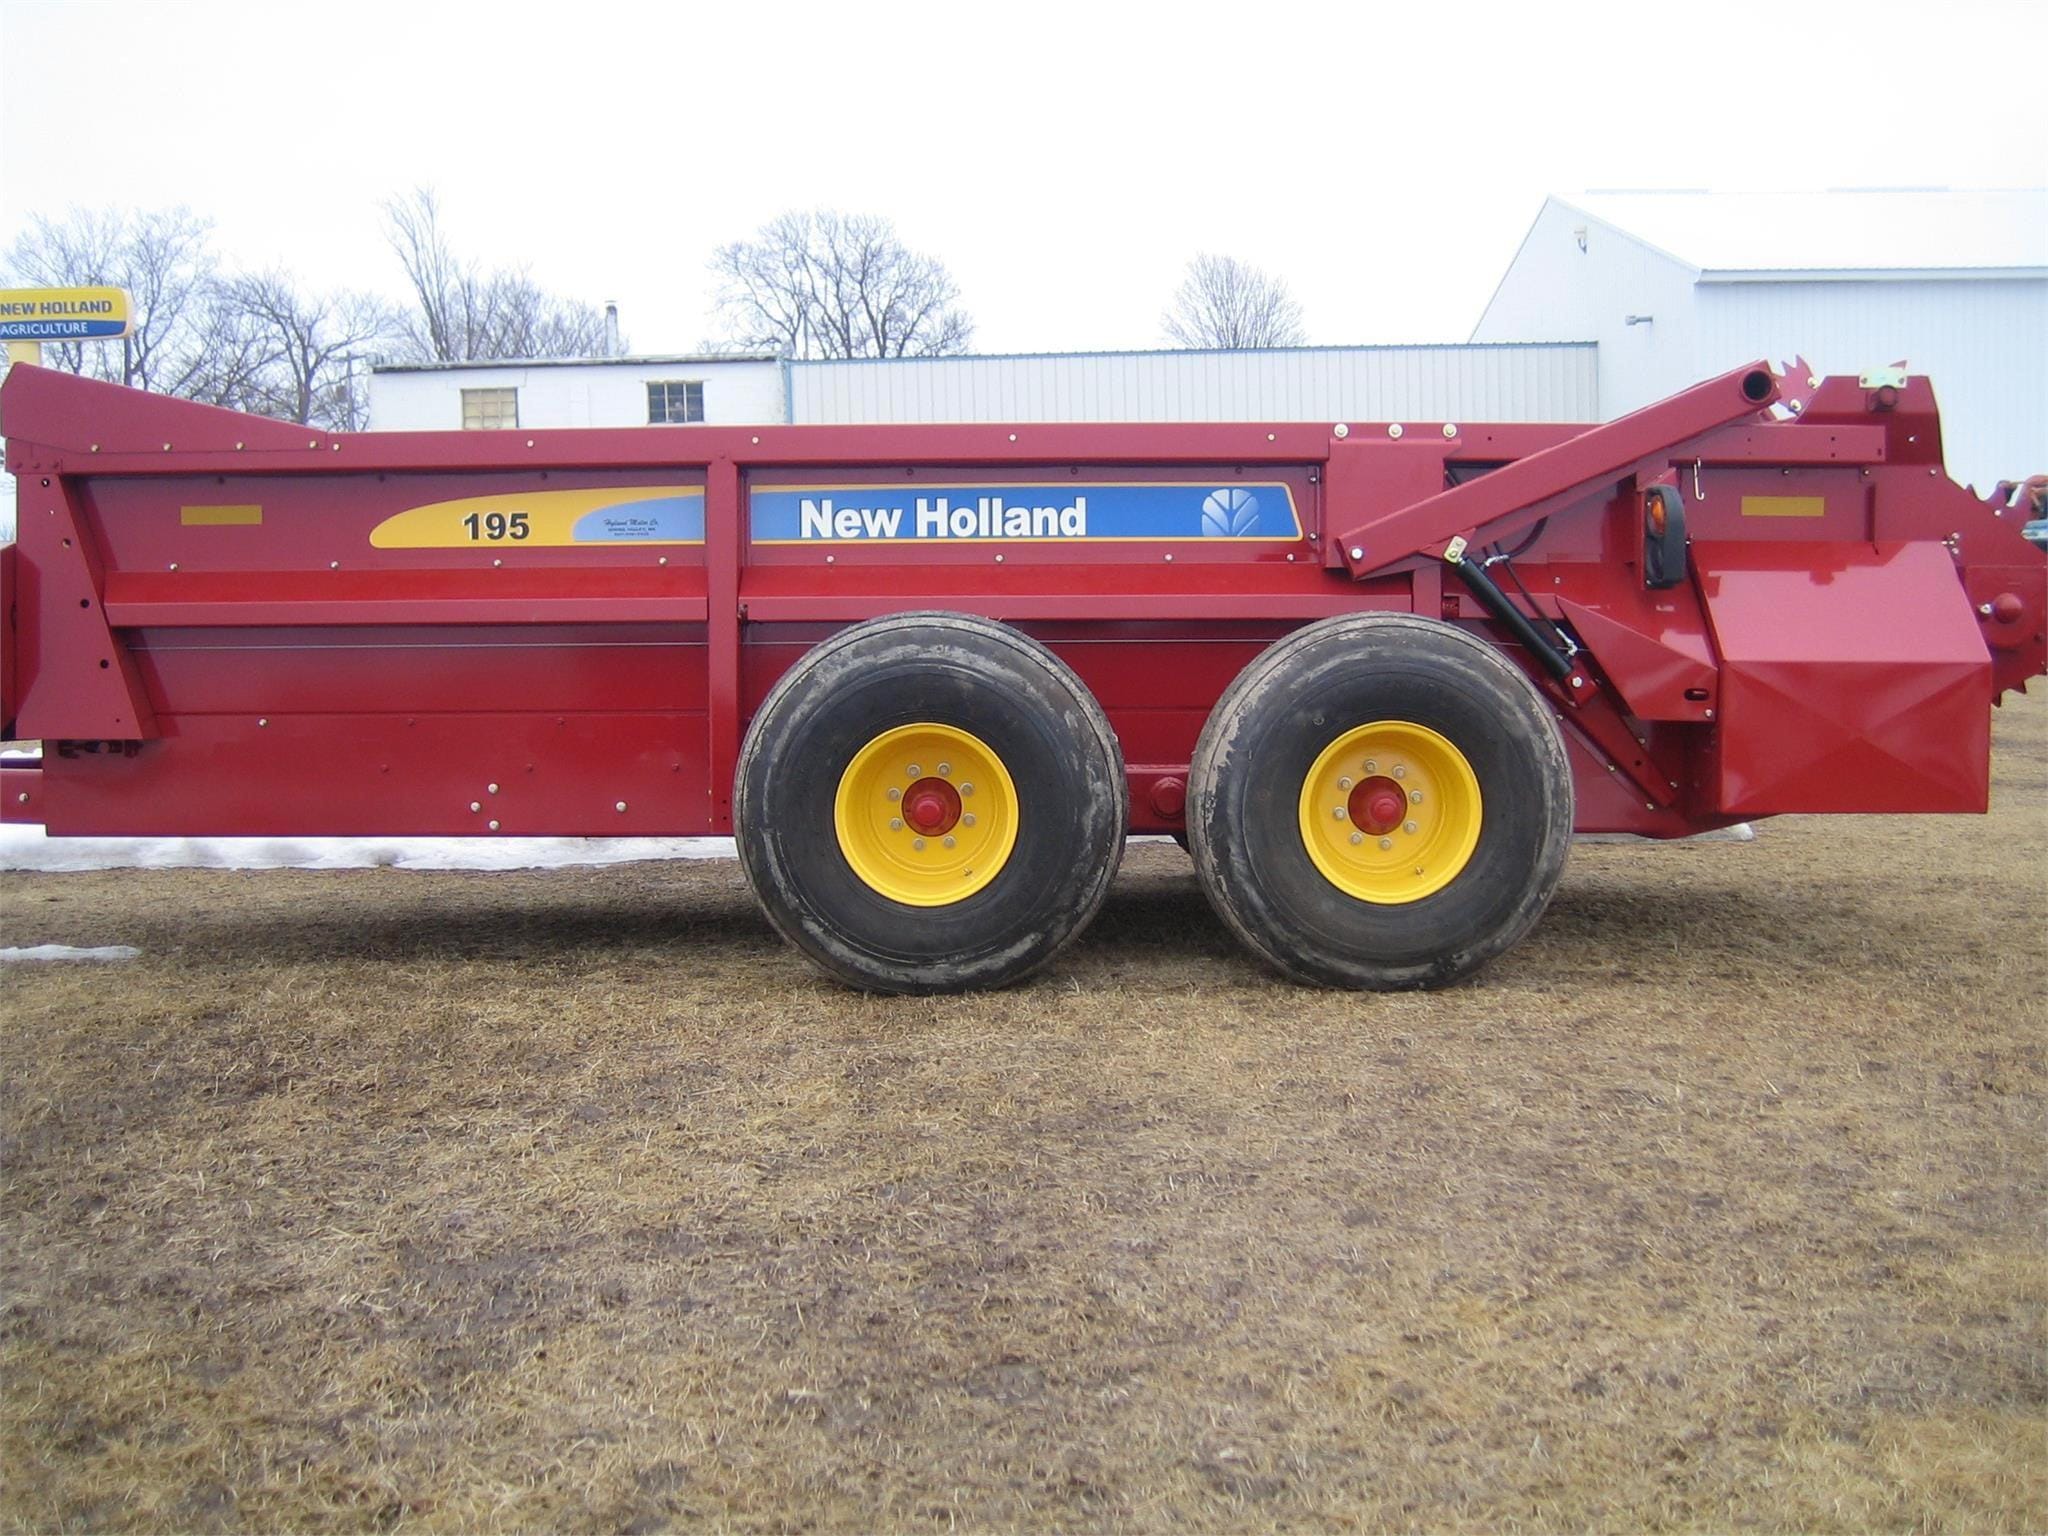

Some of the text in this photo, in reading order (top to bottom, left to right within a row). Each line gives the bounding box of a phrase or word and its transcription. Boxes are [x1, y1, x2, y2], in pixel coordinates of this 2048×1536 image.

[0, 300, 113, 316] NEW HOLLAND
[0, 322, 88, 335] AGRICULTURE
[463, 512, 530, 541] 195
[800, 496, 1087, 538] New Holland
